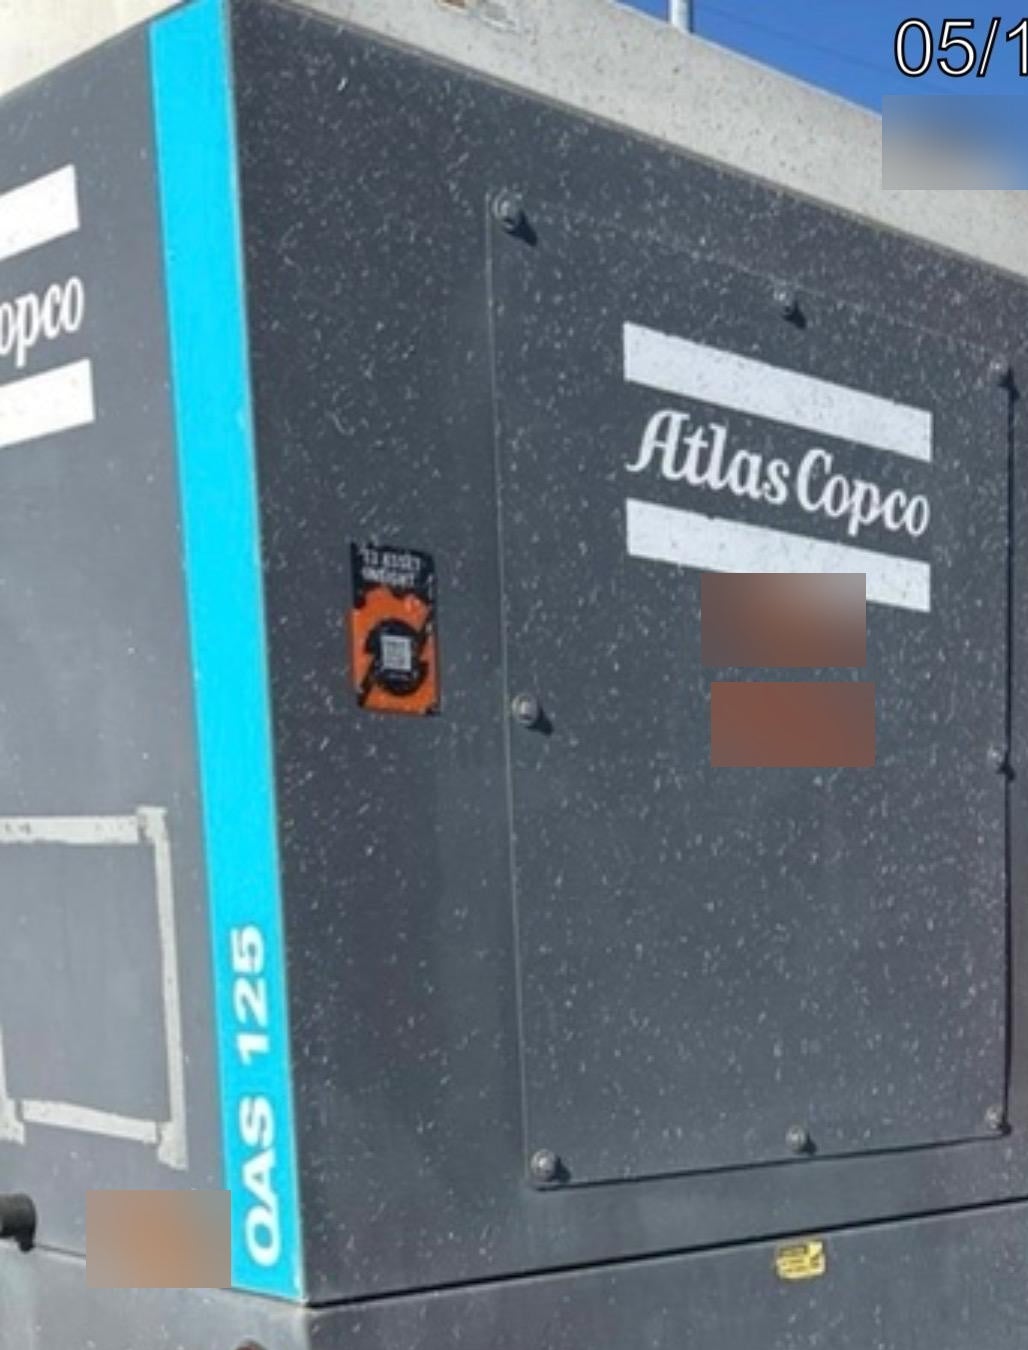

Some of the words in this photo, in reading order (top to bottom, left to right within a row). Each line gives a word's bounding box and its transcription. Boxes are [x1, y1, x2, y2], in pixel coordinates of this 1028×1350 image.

[0, 276, 85, 369] opco
[626, 409, 790, 505] Atlas
[796, 448, 930, 537] Copco
[231, 924, 270, 1065] 125
[239, 1096, 281, 1267] OAS
